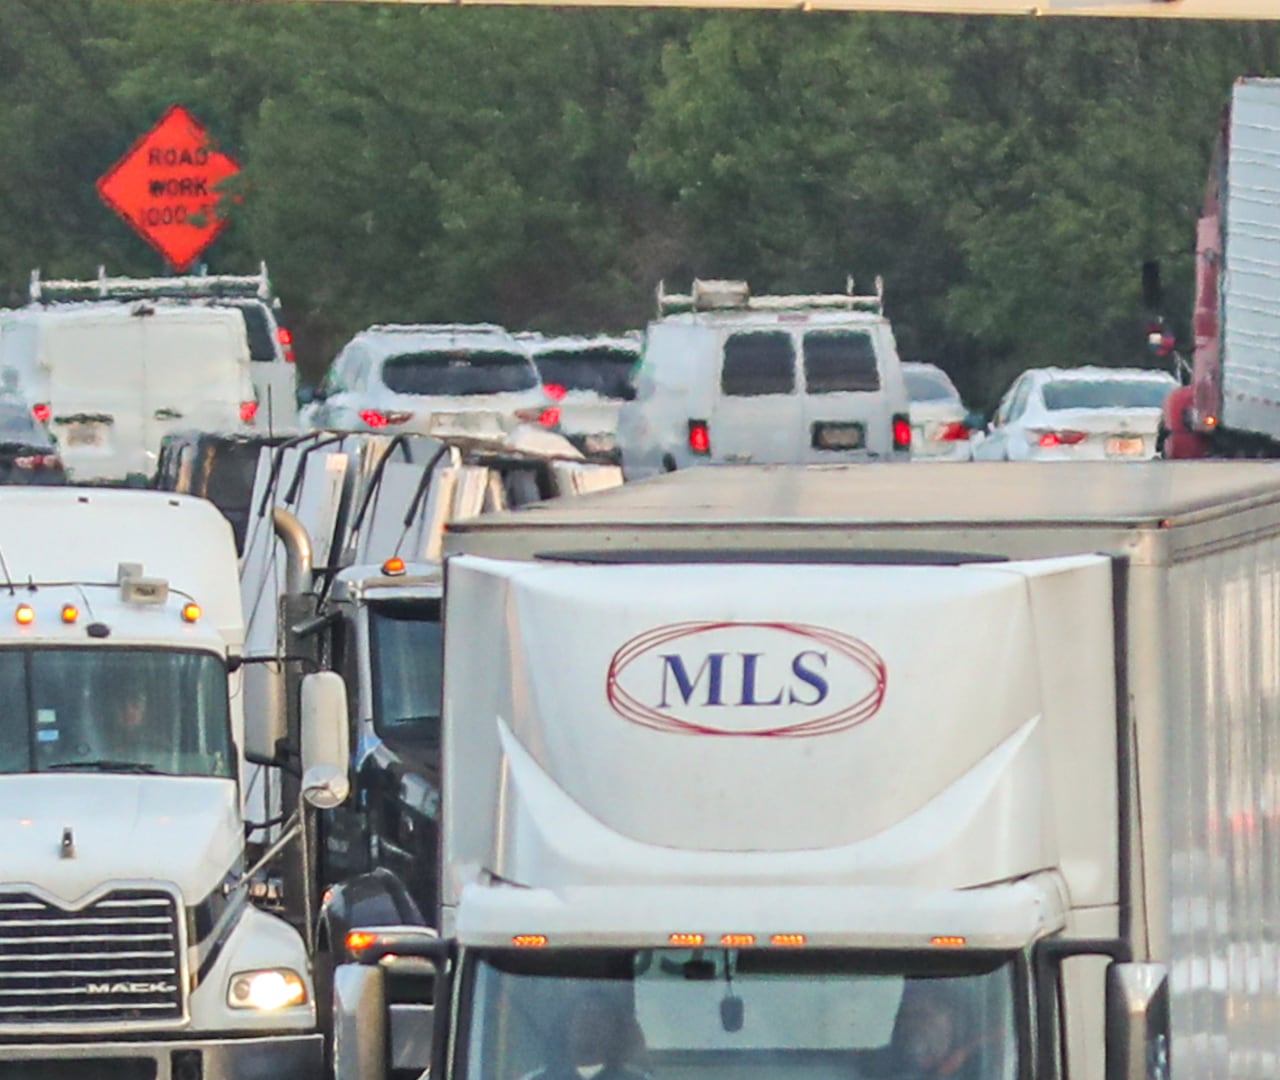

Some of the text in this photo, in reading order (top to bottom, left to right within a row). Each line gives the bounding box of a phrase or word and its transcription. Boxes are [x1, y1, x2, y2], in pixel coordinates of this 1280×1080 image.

[148, 147, 209, 167] ROAD
[149, 178, 209, 197] WORK
[656, 650, 830, 708] MLS
[86, 982, 167, 995] MACK
